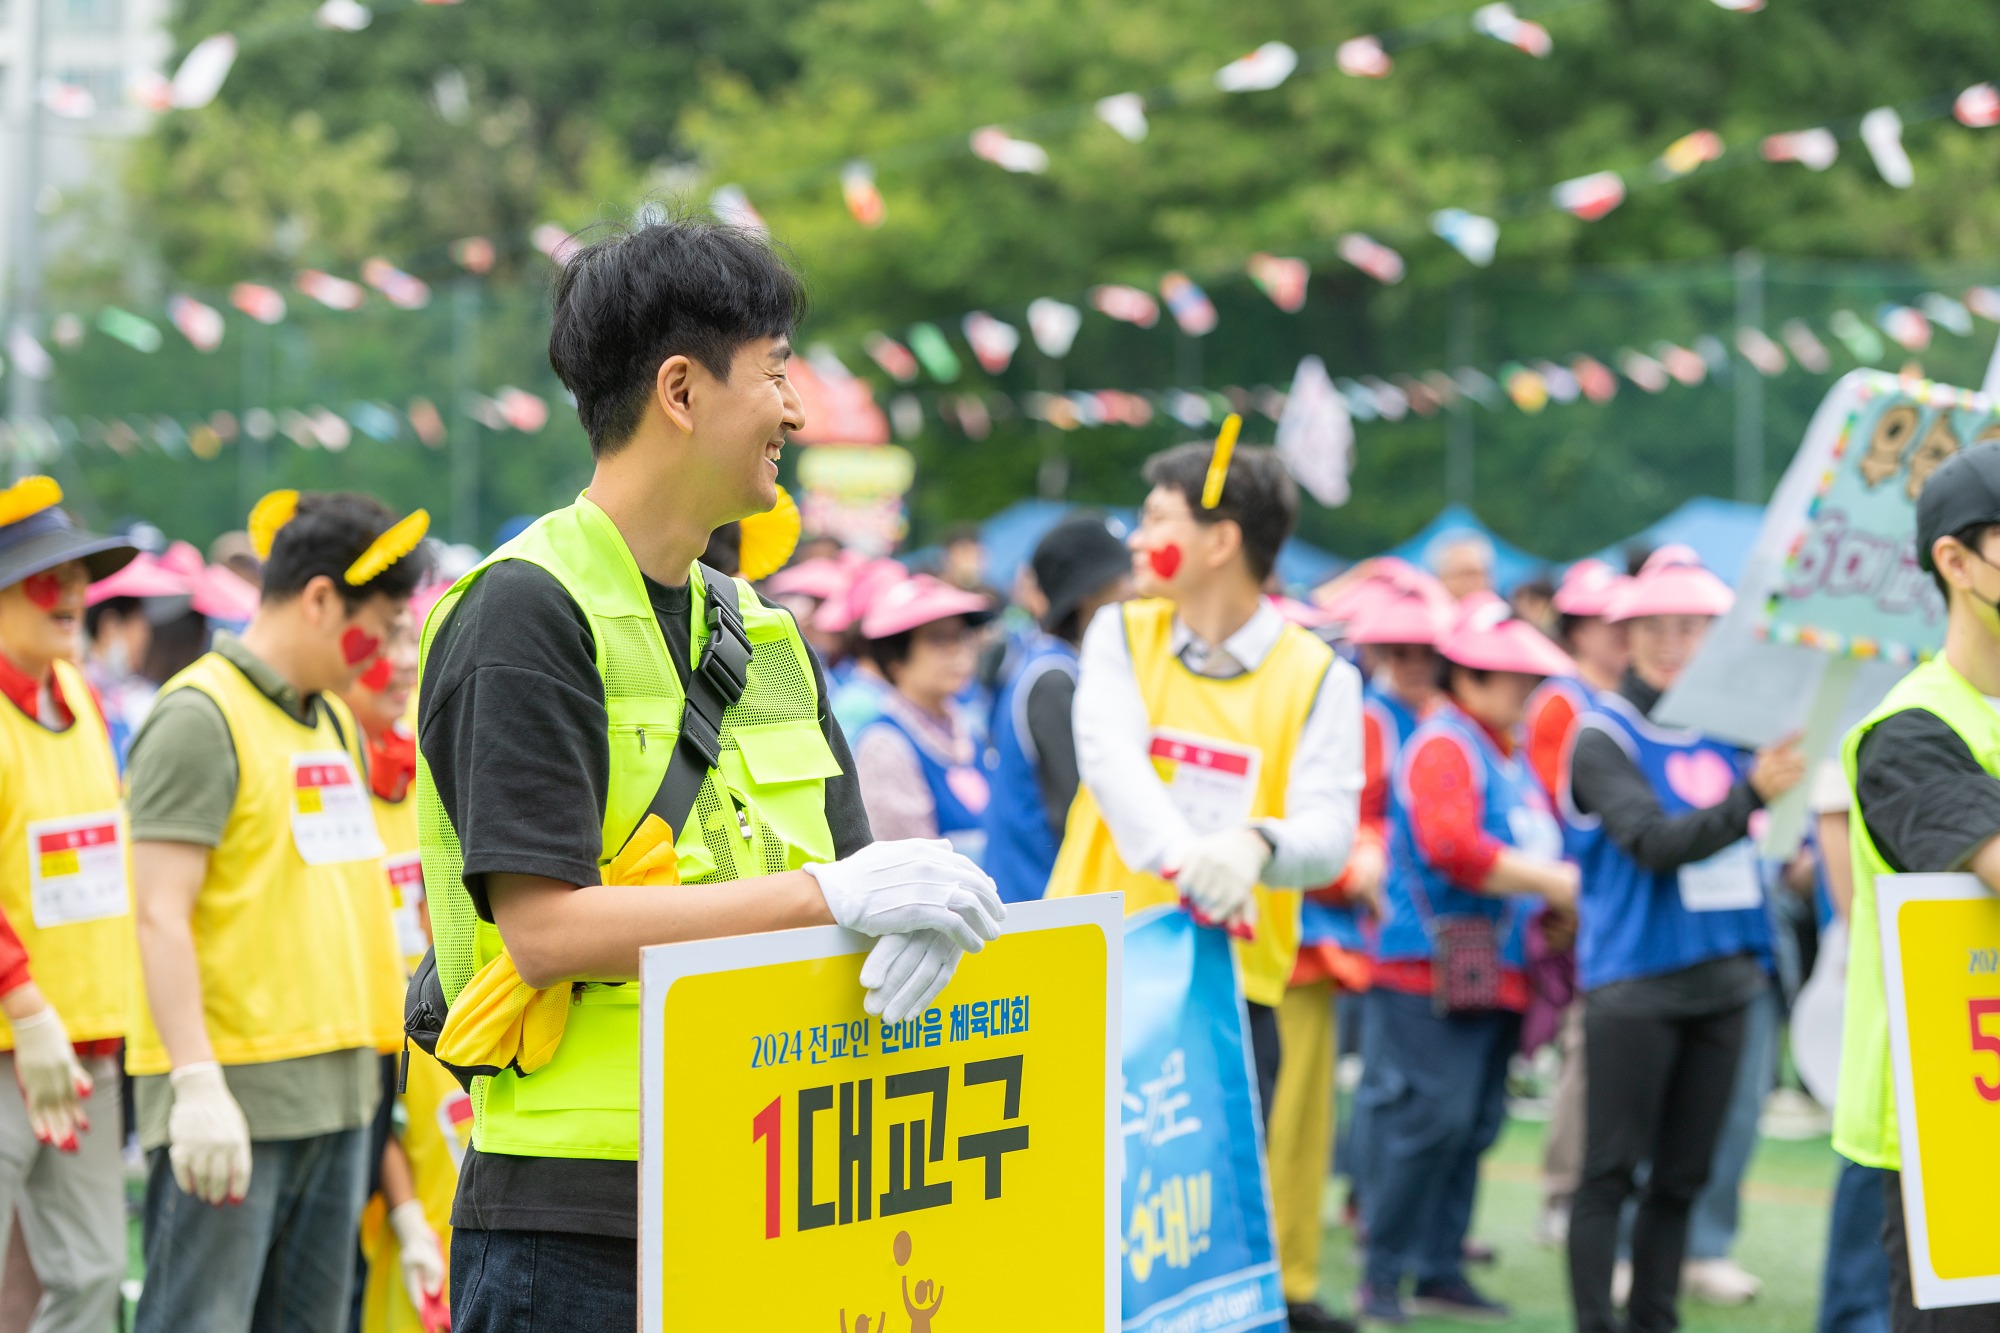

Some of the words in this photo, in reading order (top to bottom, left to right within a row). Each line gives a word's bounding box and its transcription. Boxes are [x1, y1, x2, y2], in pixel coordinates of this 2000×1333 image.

[751, 1029, 803, 1069] 2024
[808, 1018, 870, 1065] 전교인
[880, 1008, 942, 1055] 한마음
[950, 995, 1030, 1042] 체육대회
[753, 1054, 1029, 1240] 1대교구
